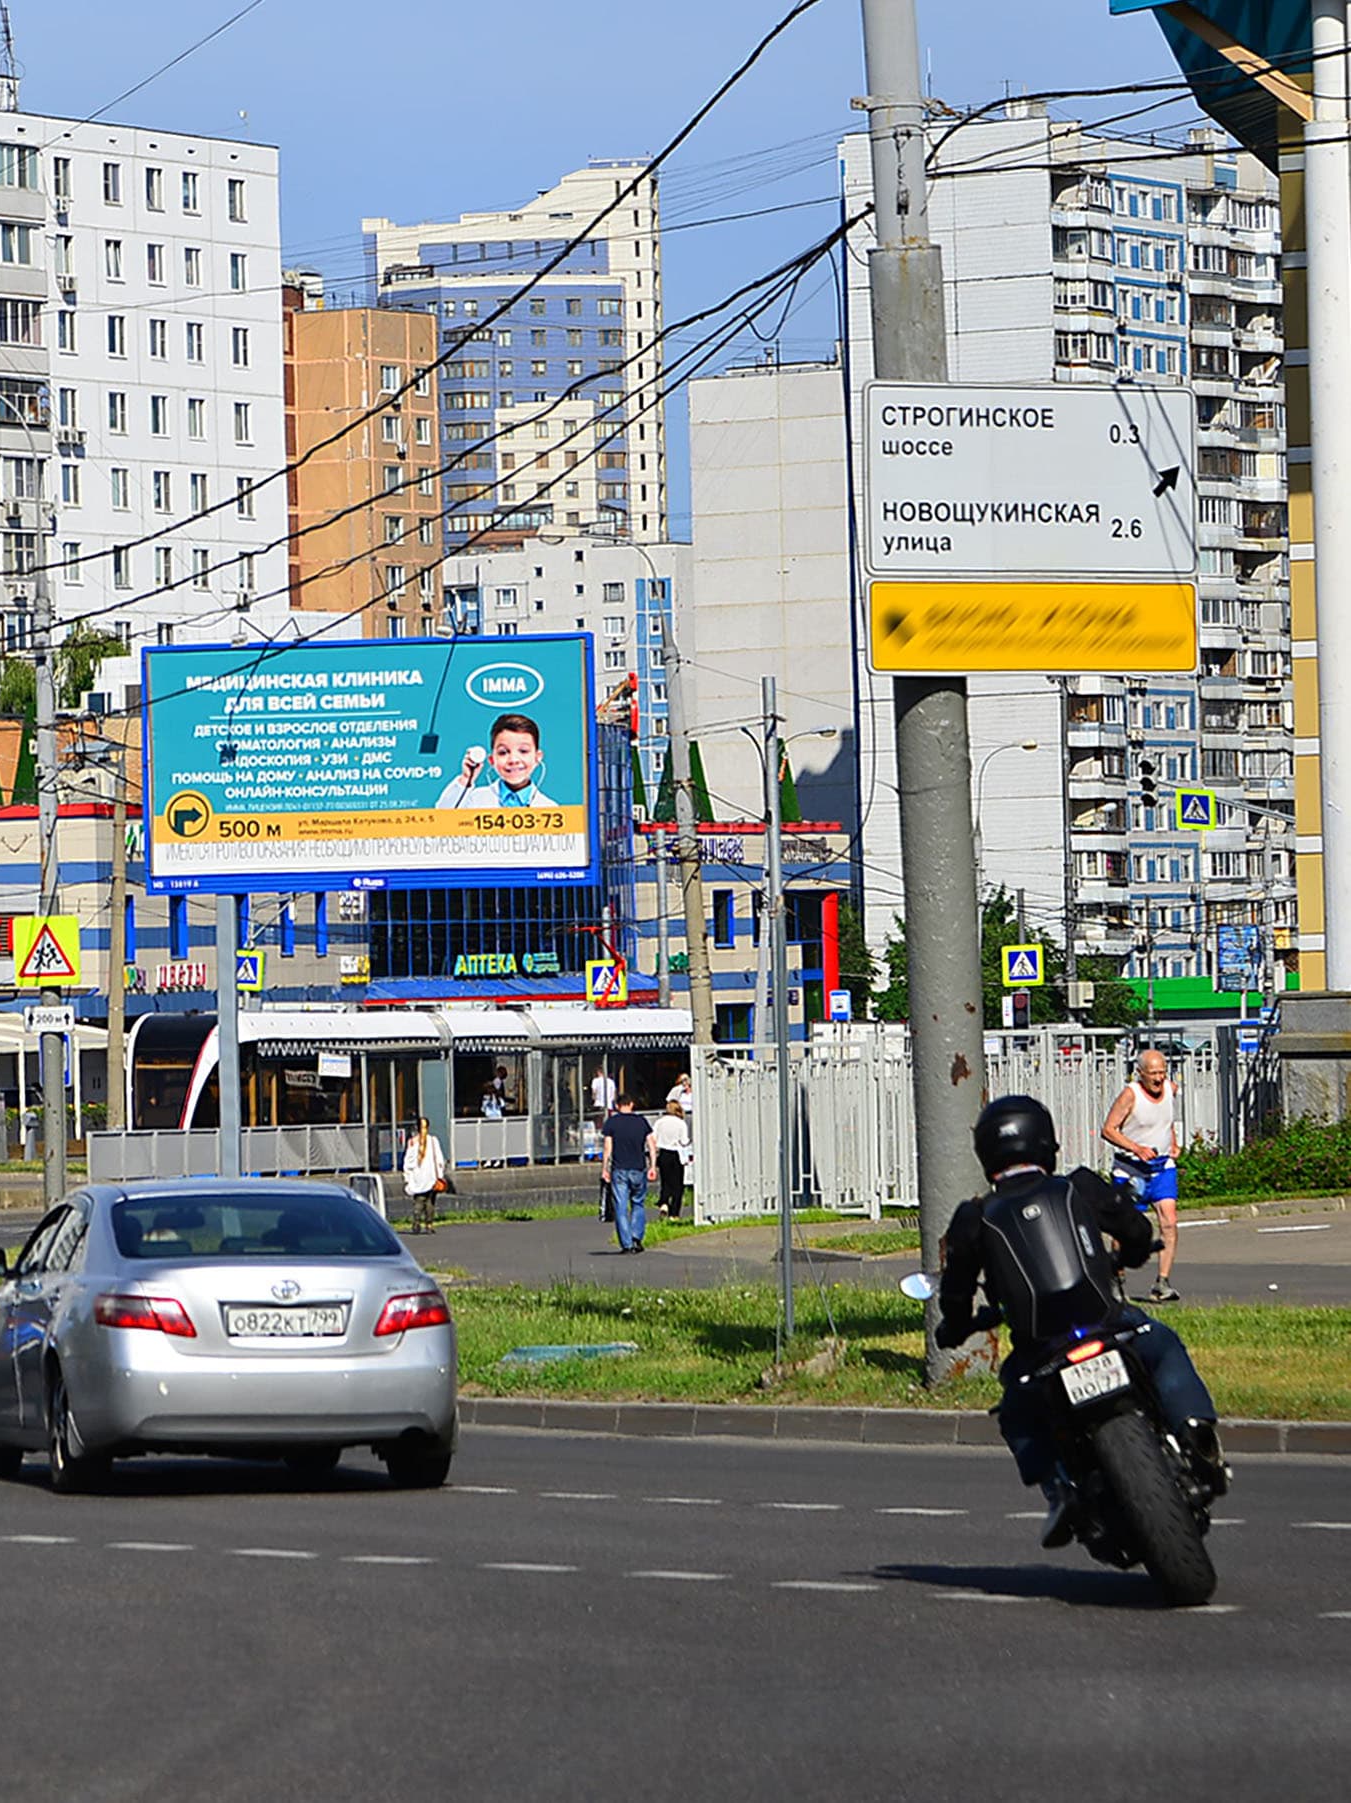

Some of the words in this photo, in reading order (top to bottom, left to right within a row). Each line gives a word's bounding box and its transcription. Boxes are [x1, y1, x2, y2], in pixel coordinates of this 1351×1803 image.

[881, 405, 1055, 428] СТРОГИНСКОЕ
[1109, 423, 1141, 444] 0.3
[881, 438, 953, 456] шоссе
[882, 501, 1100, 526] НОВОЩУКИНСКАЯ
[1111, 518, 1143, 539] 2.6
[882, 535, 952, 555] улица
[186, 673, 328, 693] МЕДИЦИНСКАЯ
[332, 670, 424, 688] КЛИНИКА
[482, 677, 527, 694] IMMA
[224, 696, 264, 714] ДЛЯ
[267, 693, 315, 711] ВСЕЙ
[317, 692, 386, 709] СЕМЬИ
[193, 723, 253, 738] ДЕТСКОЕ
[254, 723, 265, 736] И
[267, 721, 337, 735] ВЗРОСЛОЕ
[339, 719, 418, 734] ОТДЕЛЕНИЯ
[330, 735, 397, 749] АНАЛИЗЫ
[321, 753, 348, 767] УЗИ
[361, 752, 393, 765] ДМС
[172, 772, 233, 786] ПОМОЩЬ
[235, 771, 254, 783] НА
[256, 770, 297, 784] ДОМУ
[305, 769, 360, 781] АНАЛИЗ
[362, 768, 381, 780] НА
[384, 765, 443, 780] COVID-19
[225, 783, 389, 800] ОНЛАЙН-КОНСУЛЬТАЦИИ
[219, 819, 260, 838] 500
[473, 812, 565, 830] 154-03-73
[453, 953, 518, 976] АПТЕКА
[234, 1312, 306, 1332] О822КТ
[310, 1309, 338, 1327] 799
